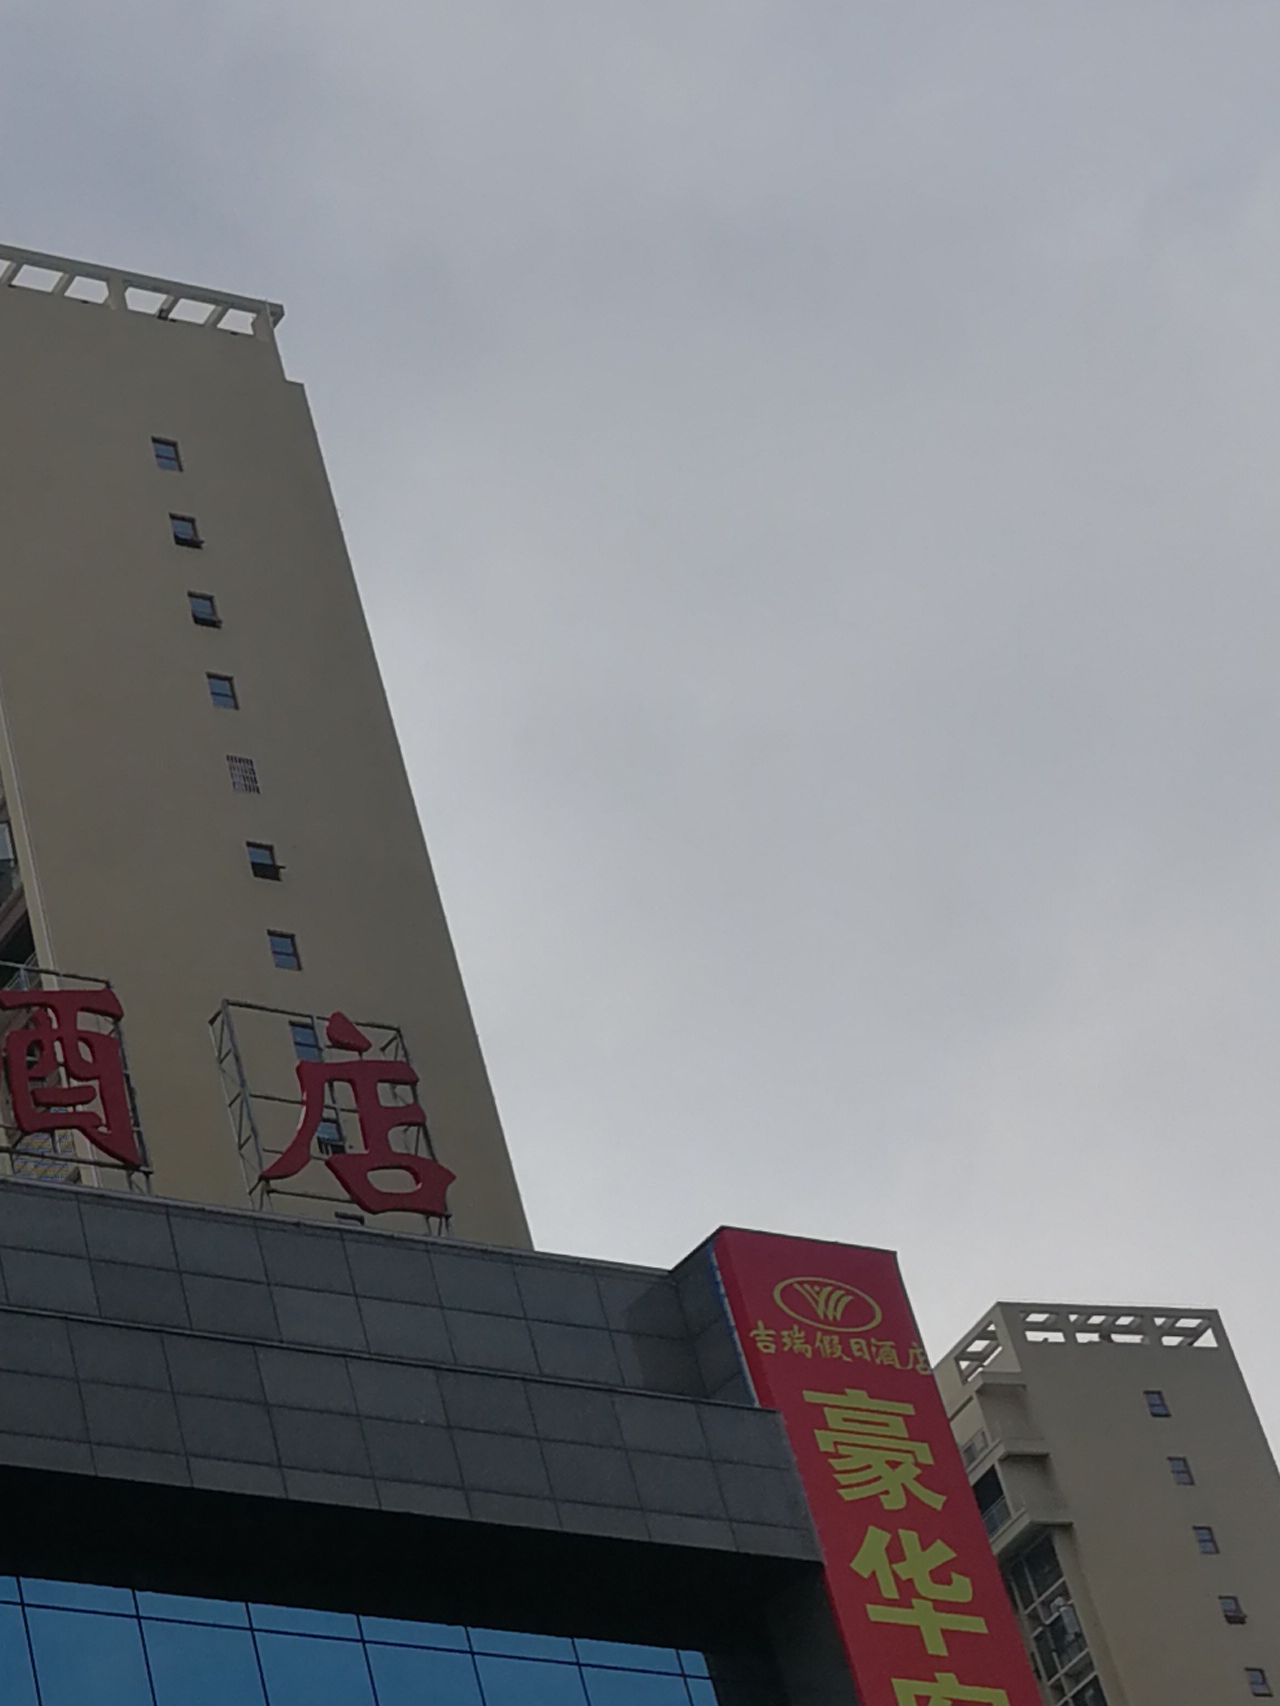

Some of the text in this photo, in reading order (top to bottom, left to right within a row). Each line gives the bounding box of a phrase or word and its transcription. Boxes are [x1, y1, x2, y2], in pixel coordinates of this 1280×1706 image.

[749, 1319, 933, 1375] 吉瑞假日酒店
